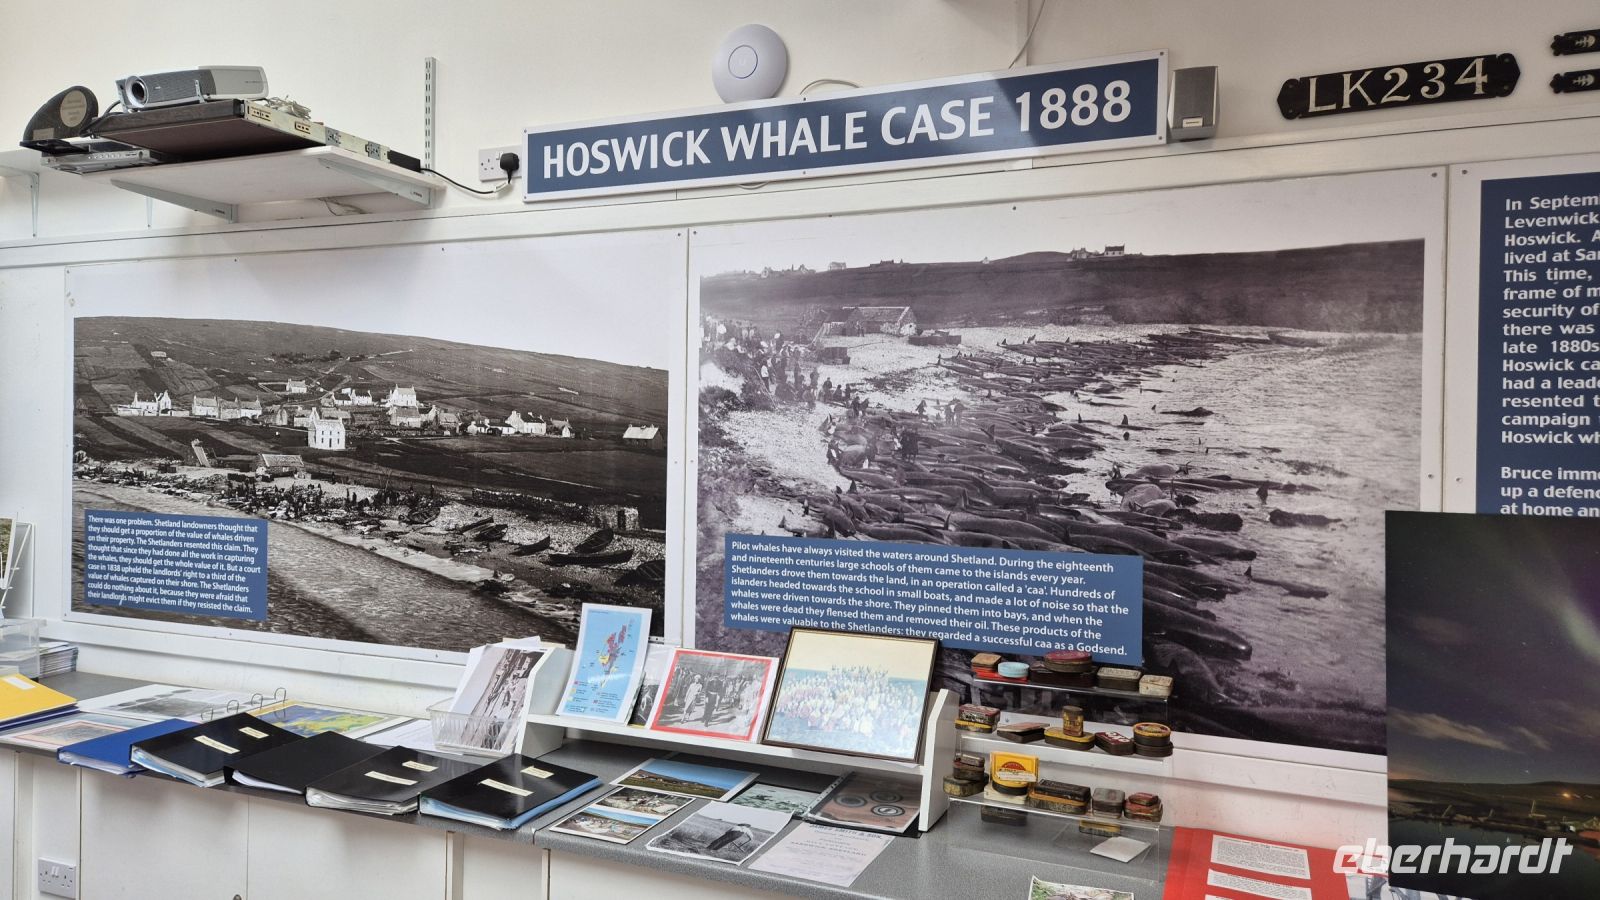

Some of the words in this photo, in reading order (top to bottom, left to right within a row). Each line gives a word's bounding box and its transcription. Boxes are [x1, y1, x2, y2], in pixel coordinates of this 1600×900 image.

[1308, 57, 1488, 112] LK234
[543, 129, 711, 179] HOSWICK
[720, 111, 868, 163] WHALE
[881, 96, 994, 145] CASE
[1015, 79, 1131, 132] 1888
[1506, 199, 1521, 210] In
[1530, 196, 1600, 210] Septem
[1506, 212, 1598, 228] Levenwick
[1505, 232, 1580, 246] Hoswick.
[1505, 251, 1546, 264] lived
[1553, 250, 1569, 262] at
[1504, 270, 1536, 282] This
[1547, 268, 1592, 280] time,
[1504, 288, 1556, 300] frame
[1563, 286, 1581, 298] of
[1504, 305, 1574, 318] security
[1581, 303, 1599, 315] of
[1504, 324, 1552, 335] there
[1560, 325, 1594, 334] was
[1504, 342, 1537, 353] late
[1552, 340, 1599, 352] 1880s
[1503, 359, 1574, 371] Hoswick
[1581, 361, 1600, 370] ca
[1503, 378, 1534, 389] had
[1541, 380, 1550, 389] a
[1503, 395, 1584, 407] resented
[1502, 413, 1590, 427] campaign
[1502, 431, 1573, 443] Hoswick
[1502, 467, 1552, 479] Bruce
[1558, 468, 1600, 480] imm
[1501, 487, 1522, 499] up
[1528, 488, 1538, 497] a
[1501, 503, 1518, 514] at
[1523, 503, 1573, 516] home
[154, 519, 180, 528] Shetland
[182, 520, 217, 530] landowners
[218, 523, 243, 533] thought
[244, 524, 258, 532] that
[88, 525, 100, 533] they
[187, 531, 203, 539] value
[212, 532, 233, 541] whales
[234, 534, 254, 542] driven
[110, 537, 135, 545] property.
[148, 538, 182, 547] Shetlanders
[211, 542, 223, 550] this
[224, 543, 242, 551] claim.
[243, 544, 258, 554] They
[732, 541, 750, 550] Pilot
[752, 543, 780, 552] whales
[782, 544, 802, 553] have
[804, 546, 832, 557] always
[834, 548, 863, 557] visited
[866, 549, 880, 558] the
[882, 552, 912, 560] waters
[915, 554, 948, 562] around
[951, 554, 997, 565] Shetland.
[1000, 557, 1034, 570] During
[1036, 559, 1054, 569] the
[1056, 561, 1114, 572] eighteenth
[749, 555, 794, 564] nineteenth
[796, 559, 835, 568] centuries
[837, 560, 859, 571] large
[861, 561, 894, 571] schools
[896, 564, 906, 572] of
[908, 564, 932, 574] them
[975, 569, 991, 578] the
[994, 570, 1028, 580] islands
[1030, 574, 1058, 584] every
[1061, 576, 1086, 585] year.
[732, 565, 780, 576] Shetlanders
[781, 568, 805, 578] drove
[807, 570, 830, 579] them
[832, 572, 867, 582] towards
[869, 574, 884, 583] the
[886, 575, 908, 586] land,
[911, 577, 920, 586] in
[936, 581, 982, 590] operation
[985, 583, 1014, 592] called
[1051, 587, 1102, 599] Hundreds
[1104, 590, 1116, 599] of
[732, 577, 767, 587] islanders
[769, 579, 800, 589] headed
[802, 583, 837, 592] towards
[839, 584, 853, 593] the
[855, 586, 884, 596] school
[886, 588, 894, 596] in
[897, 590, 921, 598] small
[924, 590, 952, 602] boats,
[954, 594, 972, 602] and
[976, 596, 1003, 605] made
[1014, 597, 1027, 607] lot
[1030, 599, 1040, 608] of
[1042, 600, 1070, 610] noise
[1087, 603, 1108, 613] that
[1111, 604, 1128, 614] the
[731, 589, 759, 598] whales
[782, 592, 809, 602] driven
[812, 595, 846, 605] towards
[848, 597, 863, 606] the
[865, 599, 892, 609] shore.
[894, 601, 916, 612] They
[918, 604, 951, 613] pinned
[954, 606, 979, 616] them
[982, 608, 1001, 618] into
[1004, 610, 1029, 621] bays,
[1032, 613, 1051, 622] and
[1054, 614, 1082, 624] when
[1085, 616, 1102, 626] the
